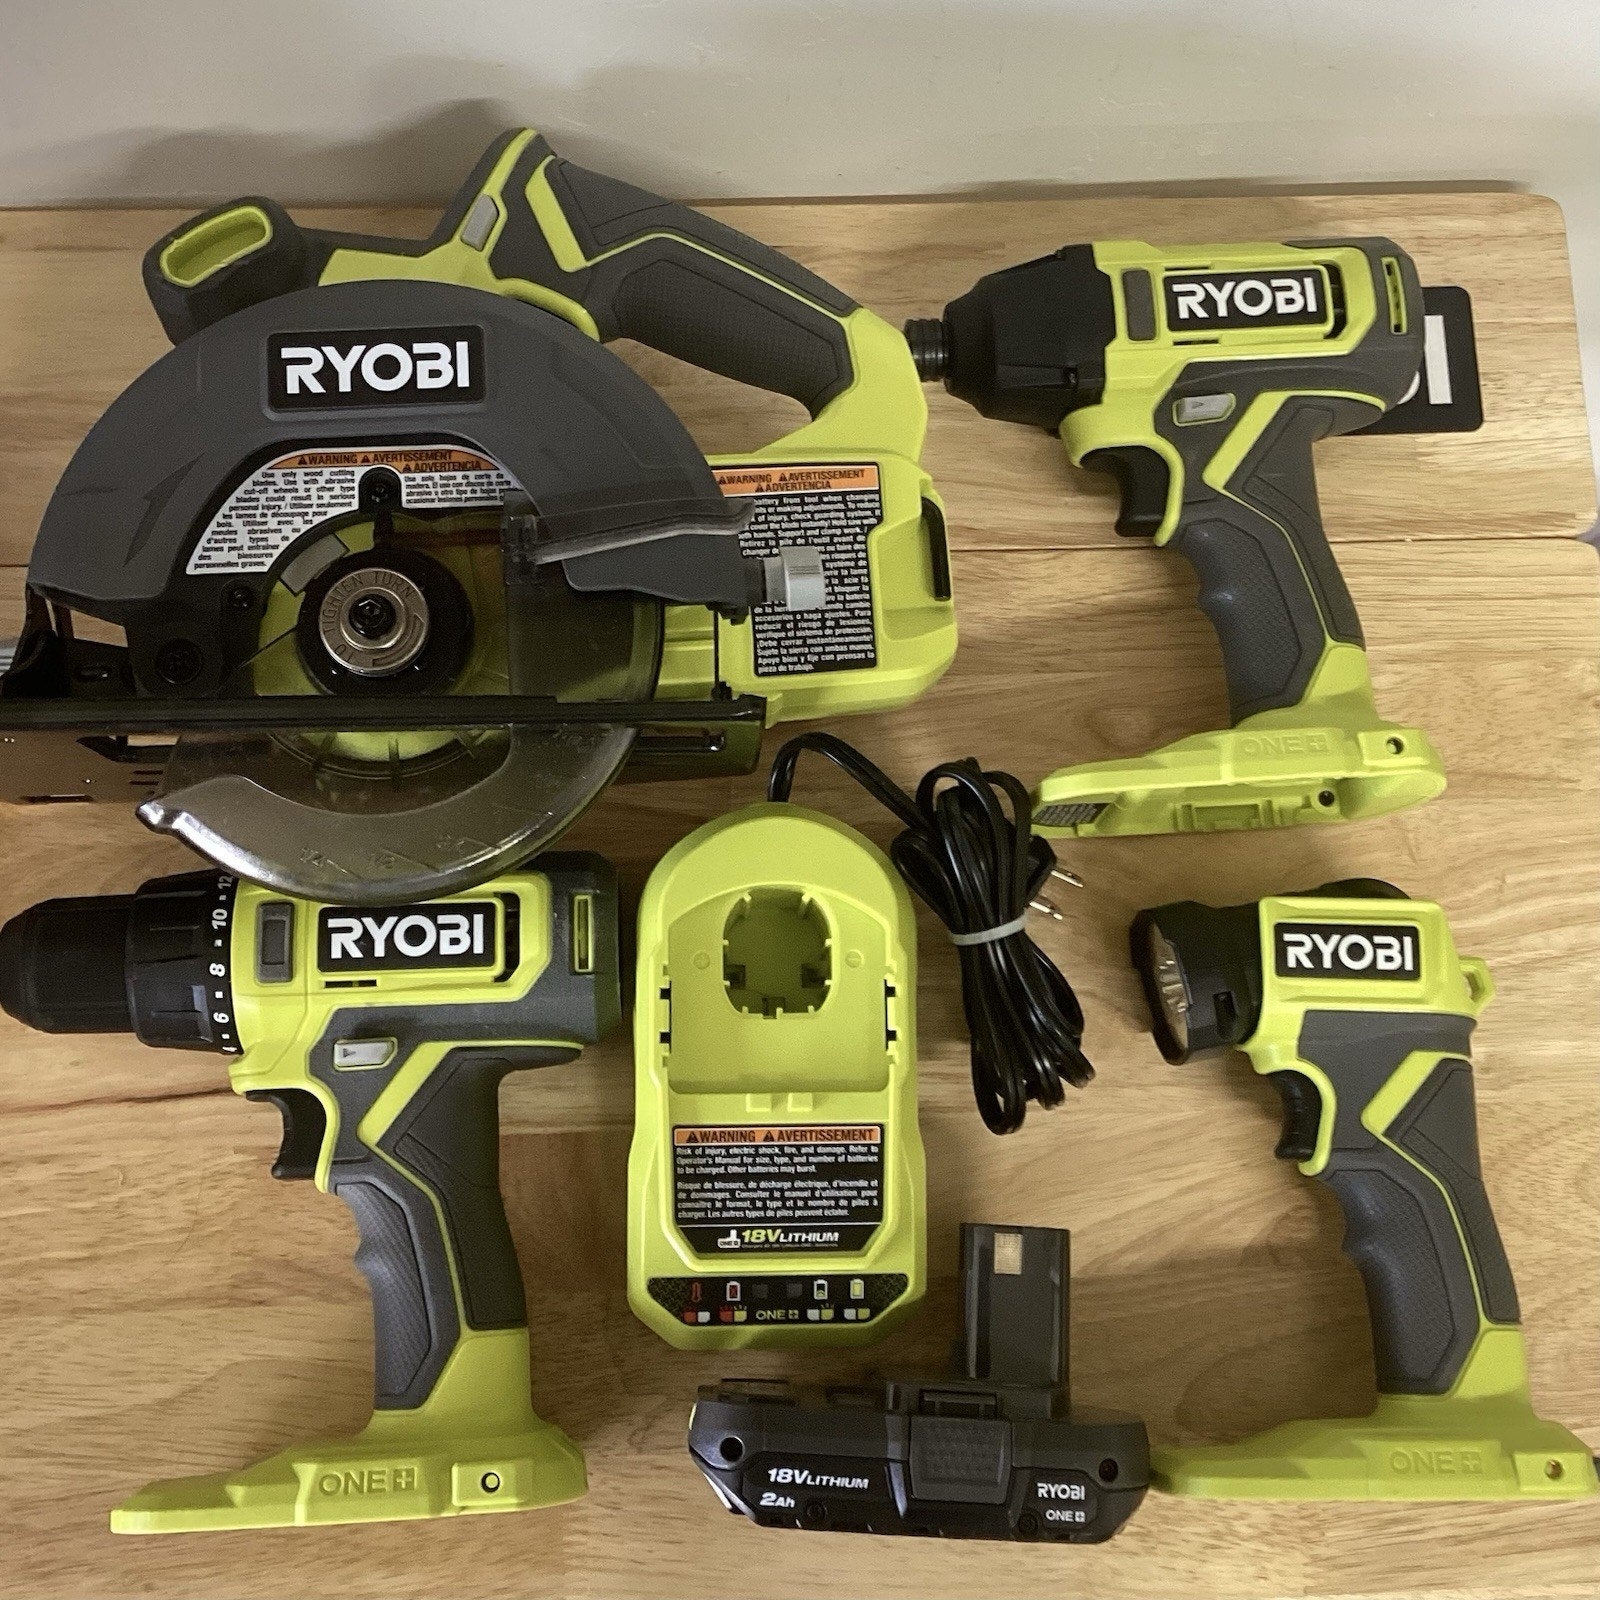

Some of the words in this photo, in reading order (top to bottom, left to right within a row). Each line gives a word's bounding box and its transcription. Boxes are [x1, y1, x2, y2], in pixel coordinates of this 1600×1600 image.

[1173, 278, 1316, 318] RYOBI
[281, 341, 469, 393] RYOBI
[308, 454, 357, 464] WARNING
[373, 451, 452, 463] AVERTISSEMENT
[415, 461, 481, 471] ADVERTENCIA
[726, 474, 771, 483] WARNING
[788, 470, 864, 482] AVERTISSEMENT
[765, 481, 831, 492] ADVERTENCIA
[211, 908, 227, 929] 10
[328, 914, 483, 958] RYOBI
[1283, 934, 1413, 970] RYOBI
[209, 963, 225, 977] 8
[213, 1012, 229, 1023] 6
[699, 1130, 756, 1142] WARNING
[777, 1130, 874, 1142] AVERTISSEMENT
[1038, 1483, 1085, 1500] RYOBI
[760, 1492, 795, 1508] 2Ah
